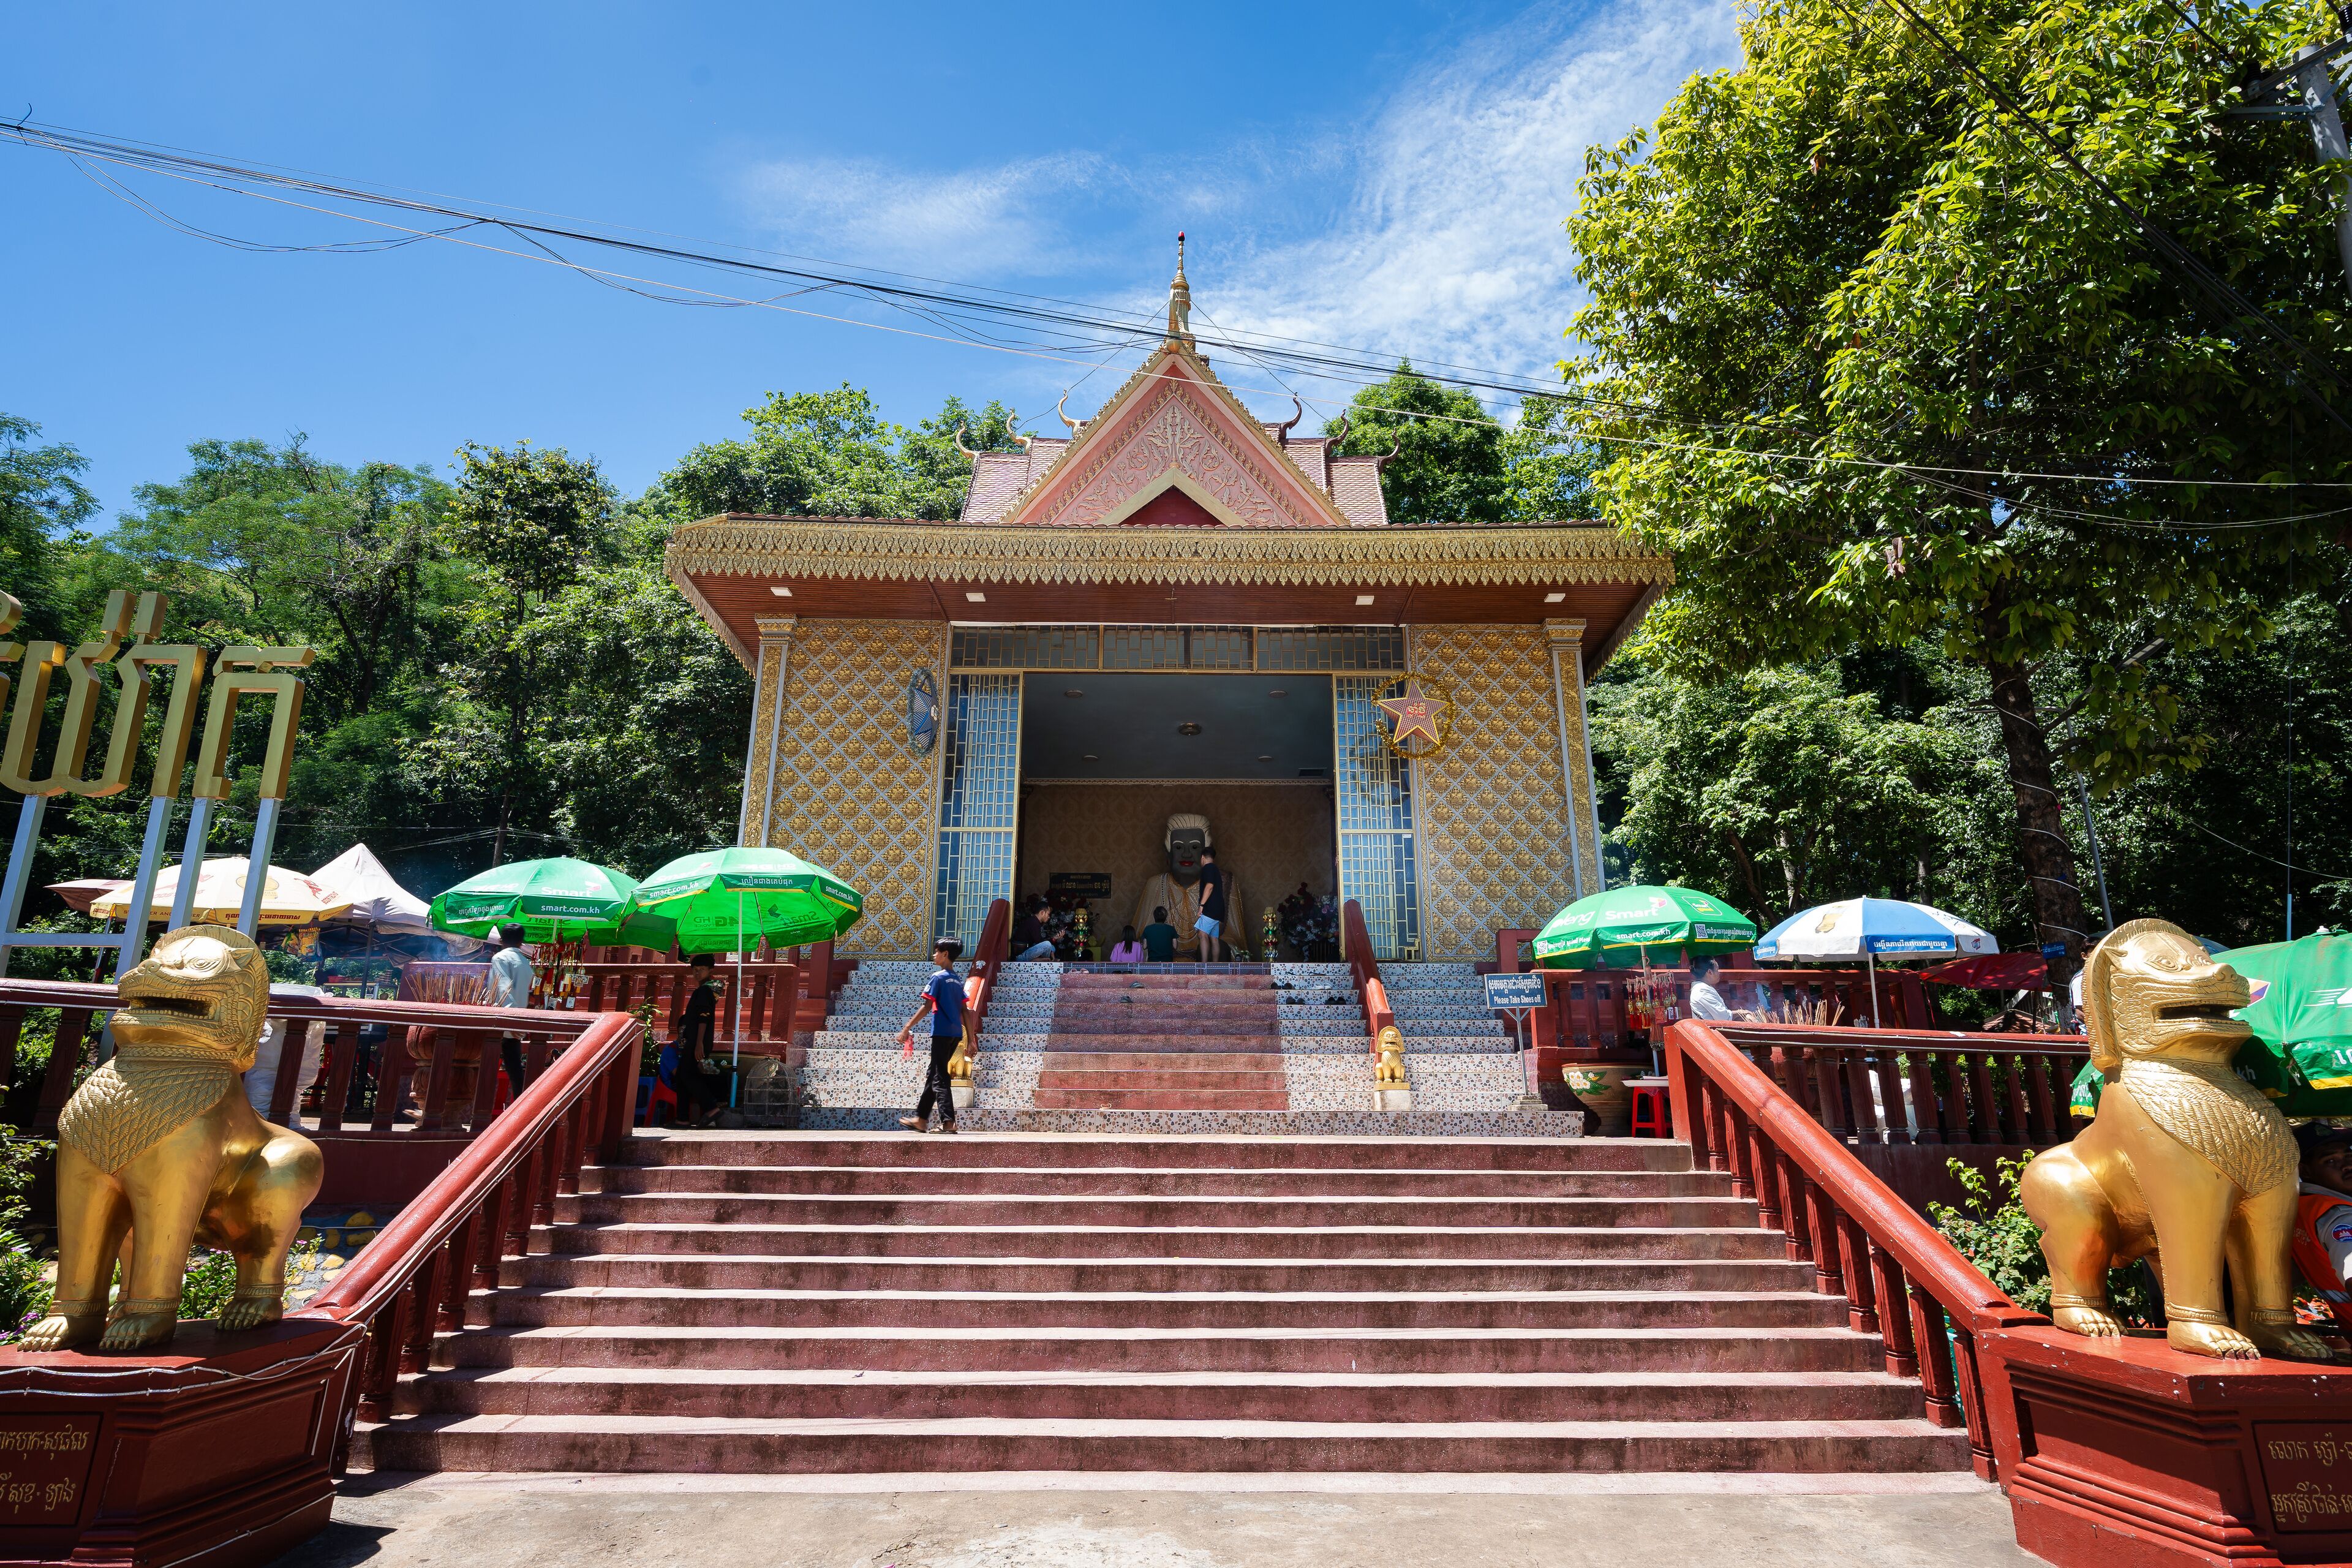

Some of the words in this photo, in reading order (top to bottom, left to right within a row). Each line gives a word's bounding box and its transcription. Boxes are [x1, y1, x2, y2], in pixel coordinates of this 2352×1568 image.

[649, 881, 699, 899] smart.com.kh
[825, 886, 854, 902] smart.com.kh
[541, 904, 600, 914] smart.com.kh
[1605, 908, 1658, 921] Smart
[1616, 928, 1671, 940] smart.com.kh
[1494, 996, 1509, 1005] Please
[1509, 995, 1520, 1004] Take
[1520, 995, 1534, 1003] Shoes
